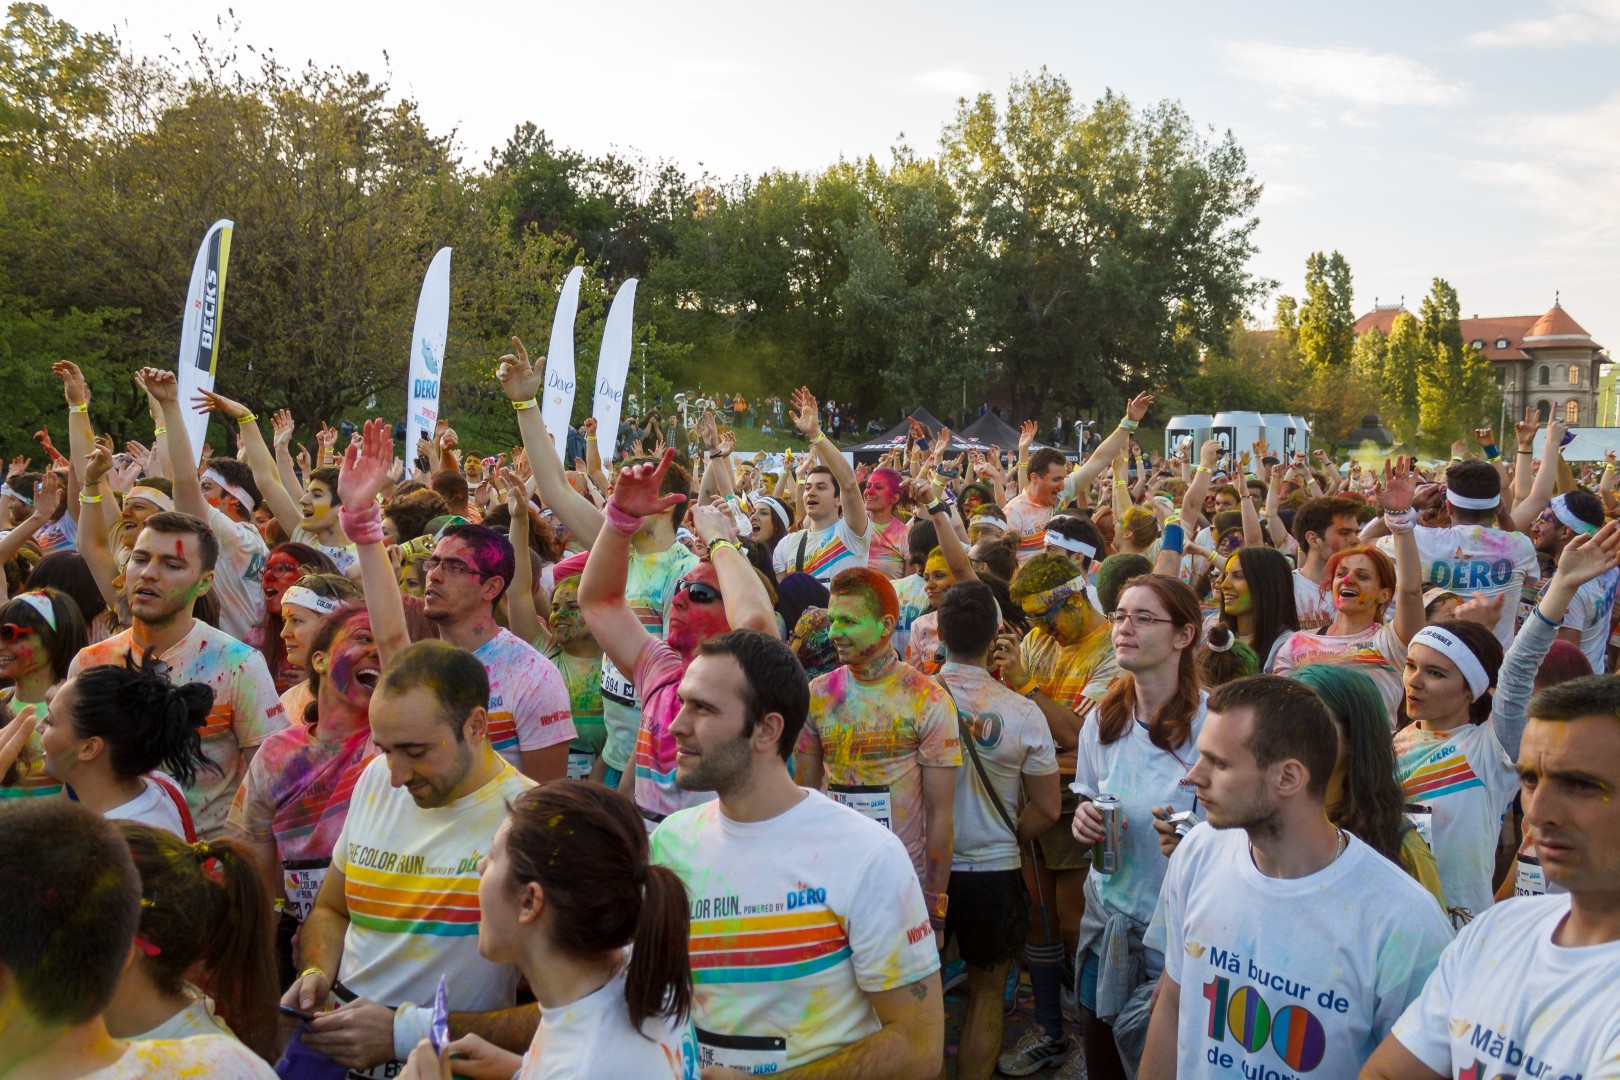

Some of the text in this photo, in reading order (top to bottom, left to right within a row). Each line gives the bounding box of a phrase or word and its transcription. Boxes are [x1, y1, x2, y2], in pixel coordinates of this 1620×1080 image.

[201, 268, 217, 350] BECK'S
[414, 379, 438, 399] DERO
[549, 369, 574, 394] Dove
[599, 377, 622, 402] Dove
[1429, 557, 1513, 590] DERO
[316, 599, 333, 611] COLOR
[1430, 631, 1453, 647] RUNNER
[605, 675, 619, 694] 694
[871, 799, 886, 808] DERO
[359, 847, 397, 872] COLOR
[426, 867, 448, 875] POWERED
[447, 867, 456, 875] BY
[299, 871, 310, 881] THE
[300, 880, 319, 890] COLOR
[690, 899, 711, 920] LOR
[743, 903, 775, 915] POWERED
[775, 903, 785, 912] BY
[786, 887, 827, 910] DERO
[1209, 946, 1350, 1014] Mă bucur de
[1202, 974, 1327, 1074] 100
[1470, 1023, 1507, 1060] Mă
[701, 1046, 715, 1062] THE
[1206, 1046, 1234, 1069] de
[753, 1062, 778, 1075] DERO
